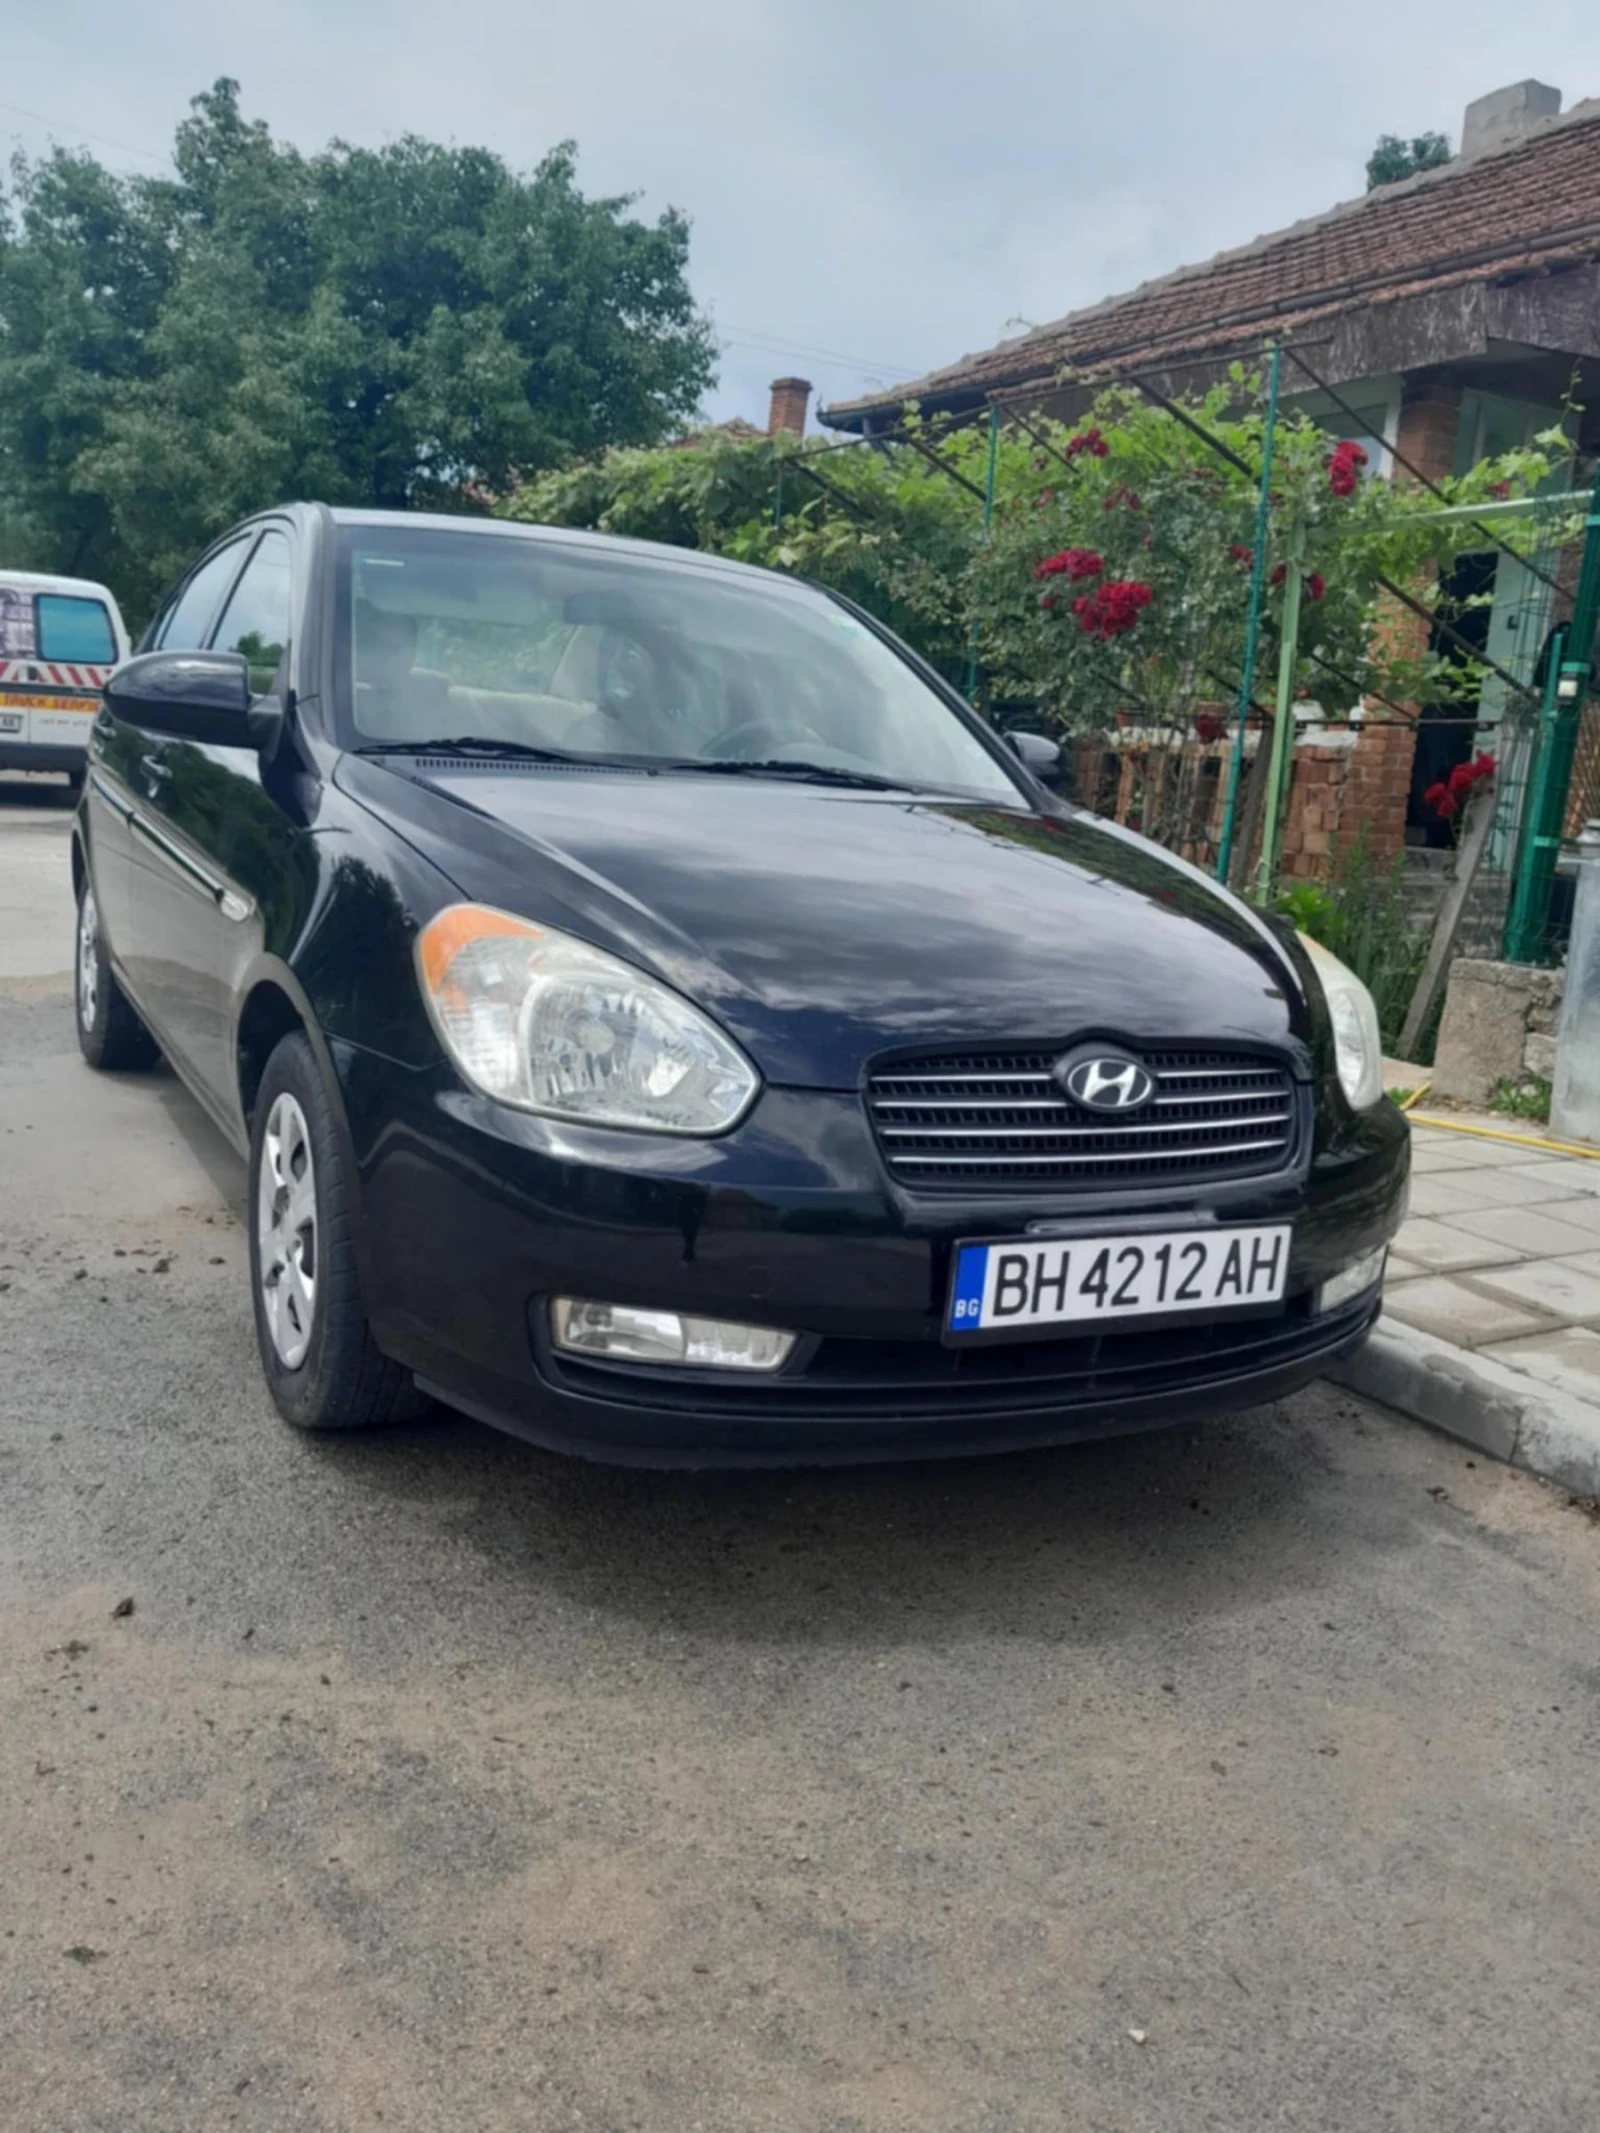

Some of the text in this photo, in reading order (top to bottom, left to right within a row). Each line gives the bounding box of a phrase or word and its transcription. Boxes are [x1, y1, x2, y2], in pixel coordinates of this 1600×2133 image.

[992, 1235, 1283, 1317] BH 4212 AH
[954, 1299, 979, 1319] BG
